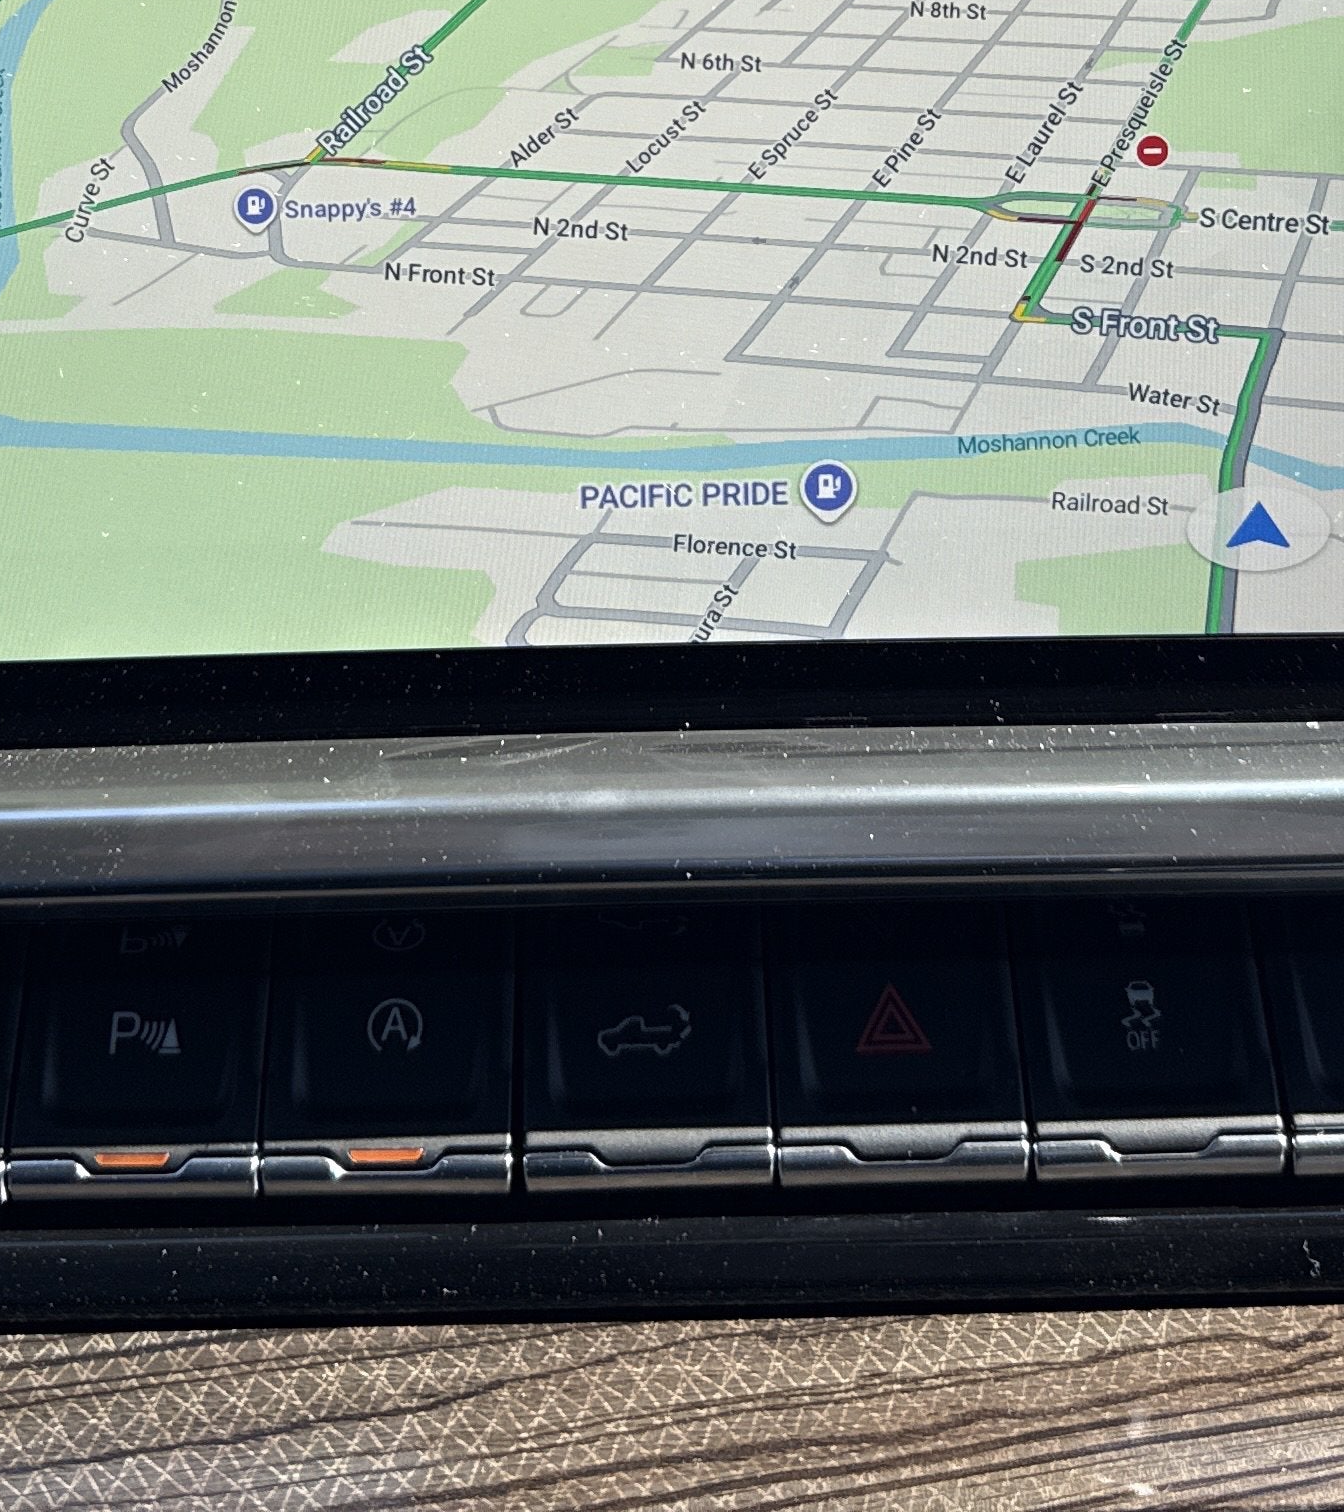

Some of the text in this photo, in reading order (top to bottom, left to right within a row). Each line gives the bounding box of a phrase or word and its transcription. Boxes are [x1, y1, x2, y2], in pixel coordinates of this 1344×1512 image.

[910, 1, 987, 20] N 8th St
[680, 52, 762, 72] N 6th St
[317, 44, 434, 156] Railroad St
[1092, 39, 1187, 187] E Presqueisle St
[510, 106, 579, 167] Alder St
[625, 100, 707, 173] Locust St
[748, 88, 839, 181] E Spruce St
[1006, 80, 1084, 185] E Laurel St
[872, 107, 942, 188] E Pine St
[65, 157, 115, 243] Curve St
[285, 198, 417, 223] Snappy's #4
[533, 218, 628, 241] N 2nd St
[1200, 208, 1329, 234] S Centre St
[932, 245, 1028, 267] N 2nd St
[1080, 255, 1174, 278] S 2nd St
[385, 263, 495, 287] N Front St
[1071, 307, 1219, 343] S Front St
[1127, 384, 1220, 416] Water St
[957, 426, 1141, 456] Moshannon Creek
[579, 481, 788, 509] PACIFIC PRIDE
[1051, 493, 1168, 516] Railroad St
[673, 534, 797, 560] Florence St
[1127, 1030, 1158, 1049] OFF
